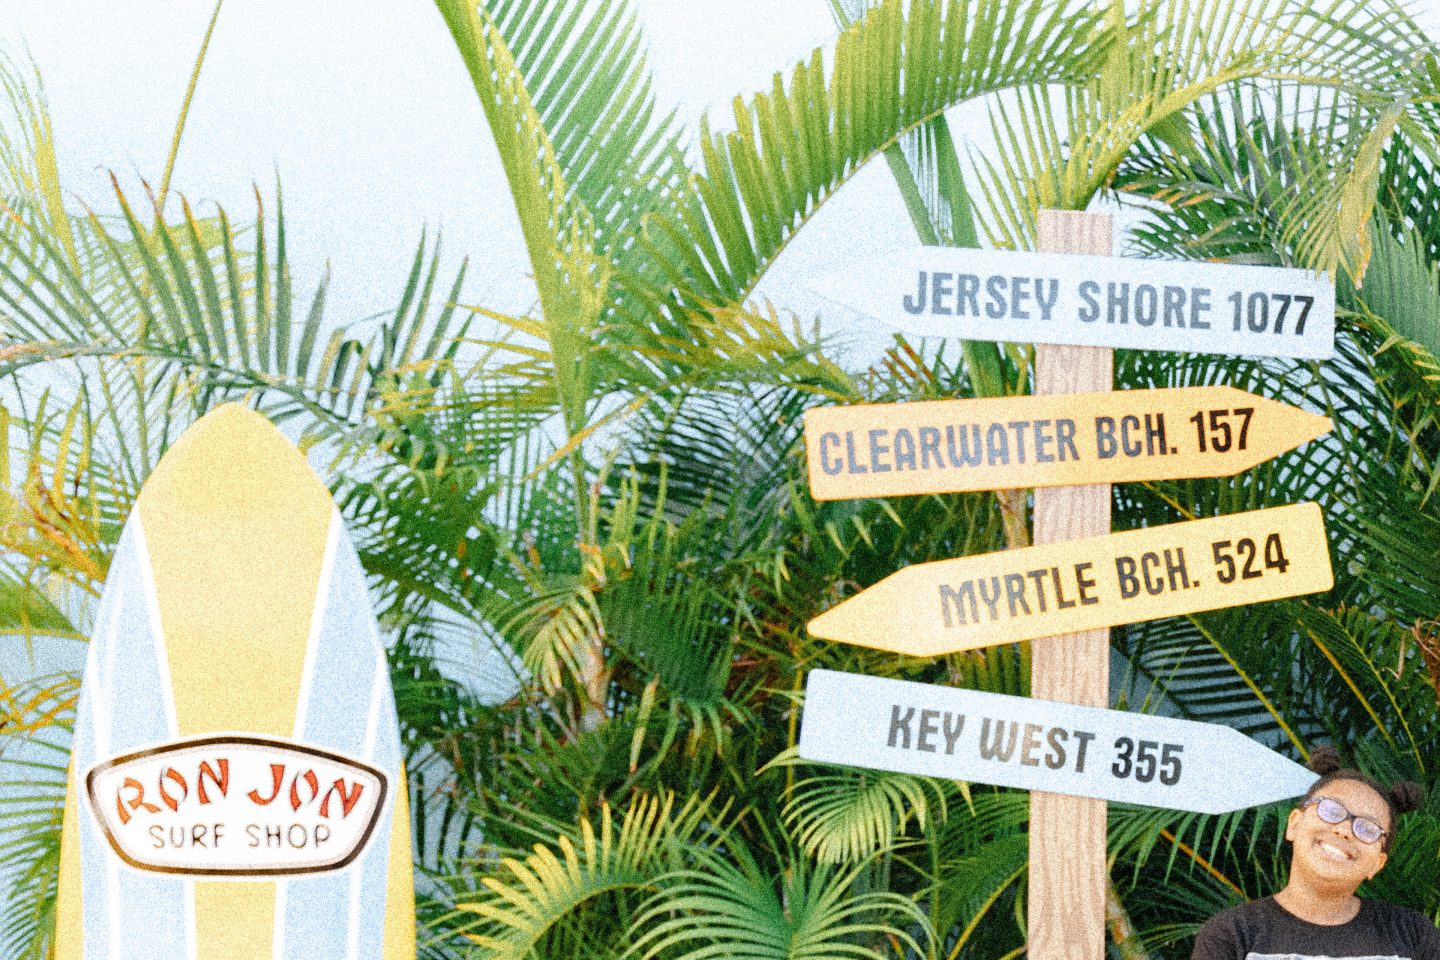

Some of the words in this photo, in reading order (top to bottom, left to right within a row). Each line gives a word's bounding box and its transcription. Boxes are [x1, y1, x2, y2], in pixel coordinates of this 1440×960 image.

[902, 271, 1060, 320] JERSEY
[1078, 280, 1212, 330] SHORE
[1228, 290, 1315, 336] 1077
[819, 418, 1081, 476] CLEARWATER
[1094, 414, 1178, 459] BCH.
[1190, 407, 1255, 454] 157
[938, 561, 1100, 628] MYRTLE
[1115, 547, 1201, 600] BCH.
[1212, 532, 1290, 585] 524
[886, 704, 966, 756] KEY
[979, 718, 1096, 774] WEST
[1110, 736, 1184, 787] 355
[116, 758, 229, 825] RON
[247, 763, 364, 818] JON
[148, 824, 225, 848] SURF
[246, 823, 331, 849] SHOP
